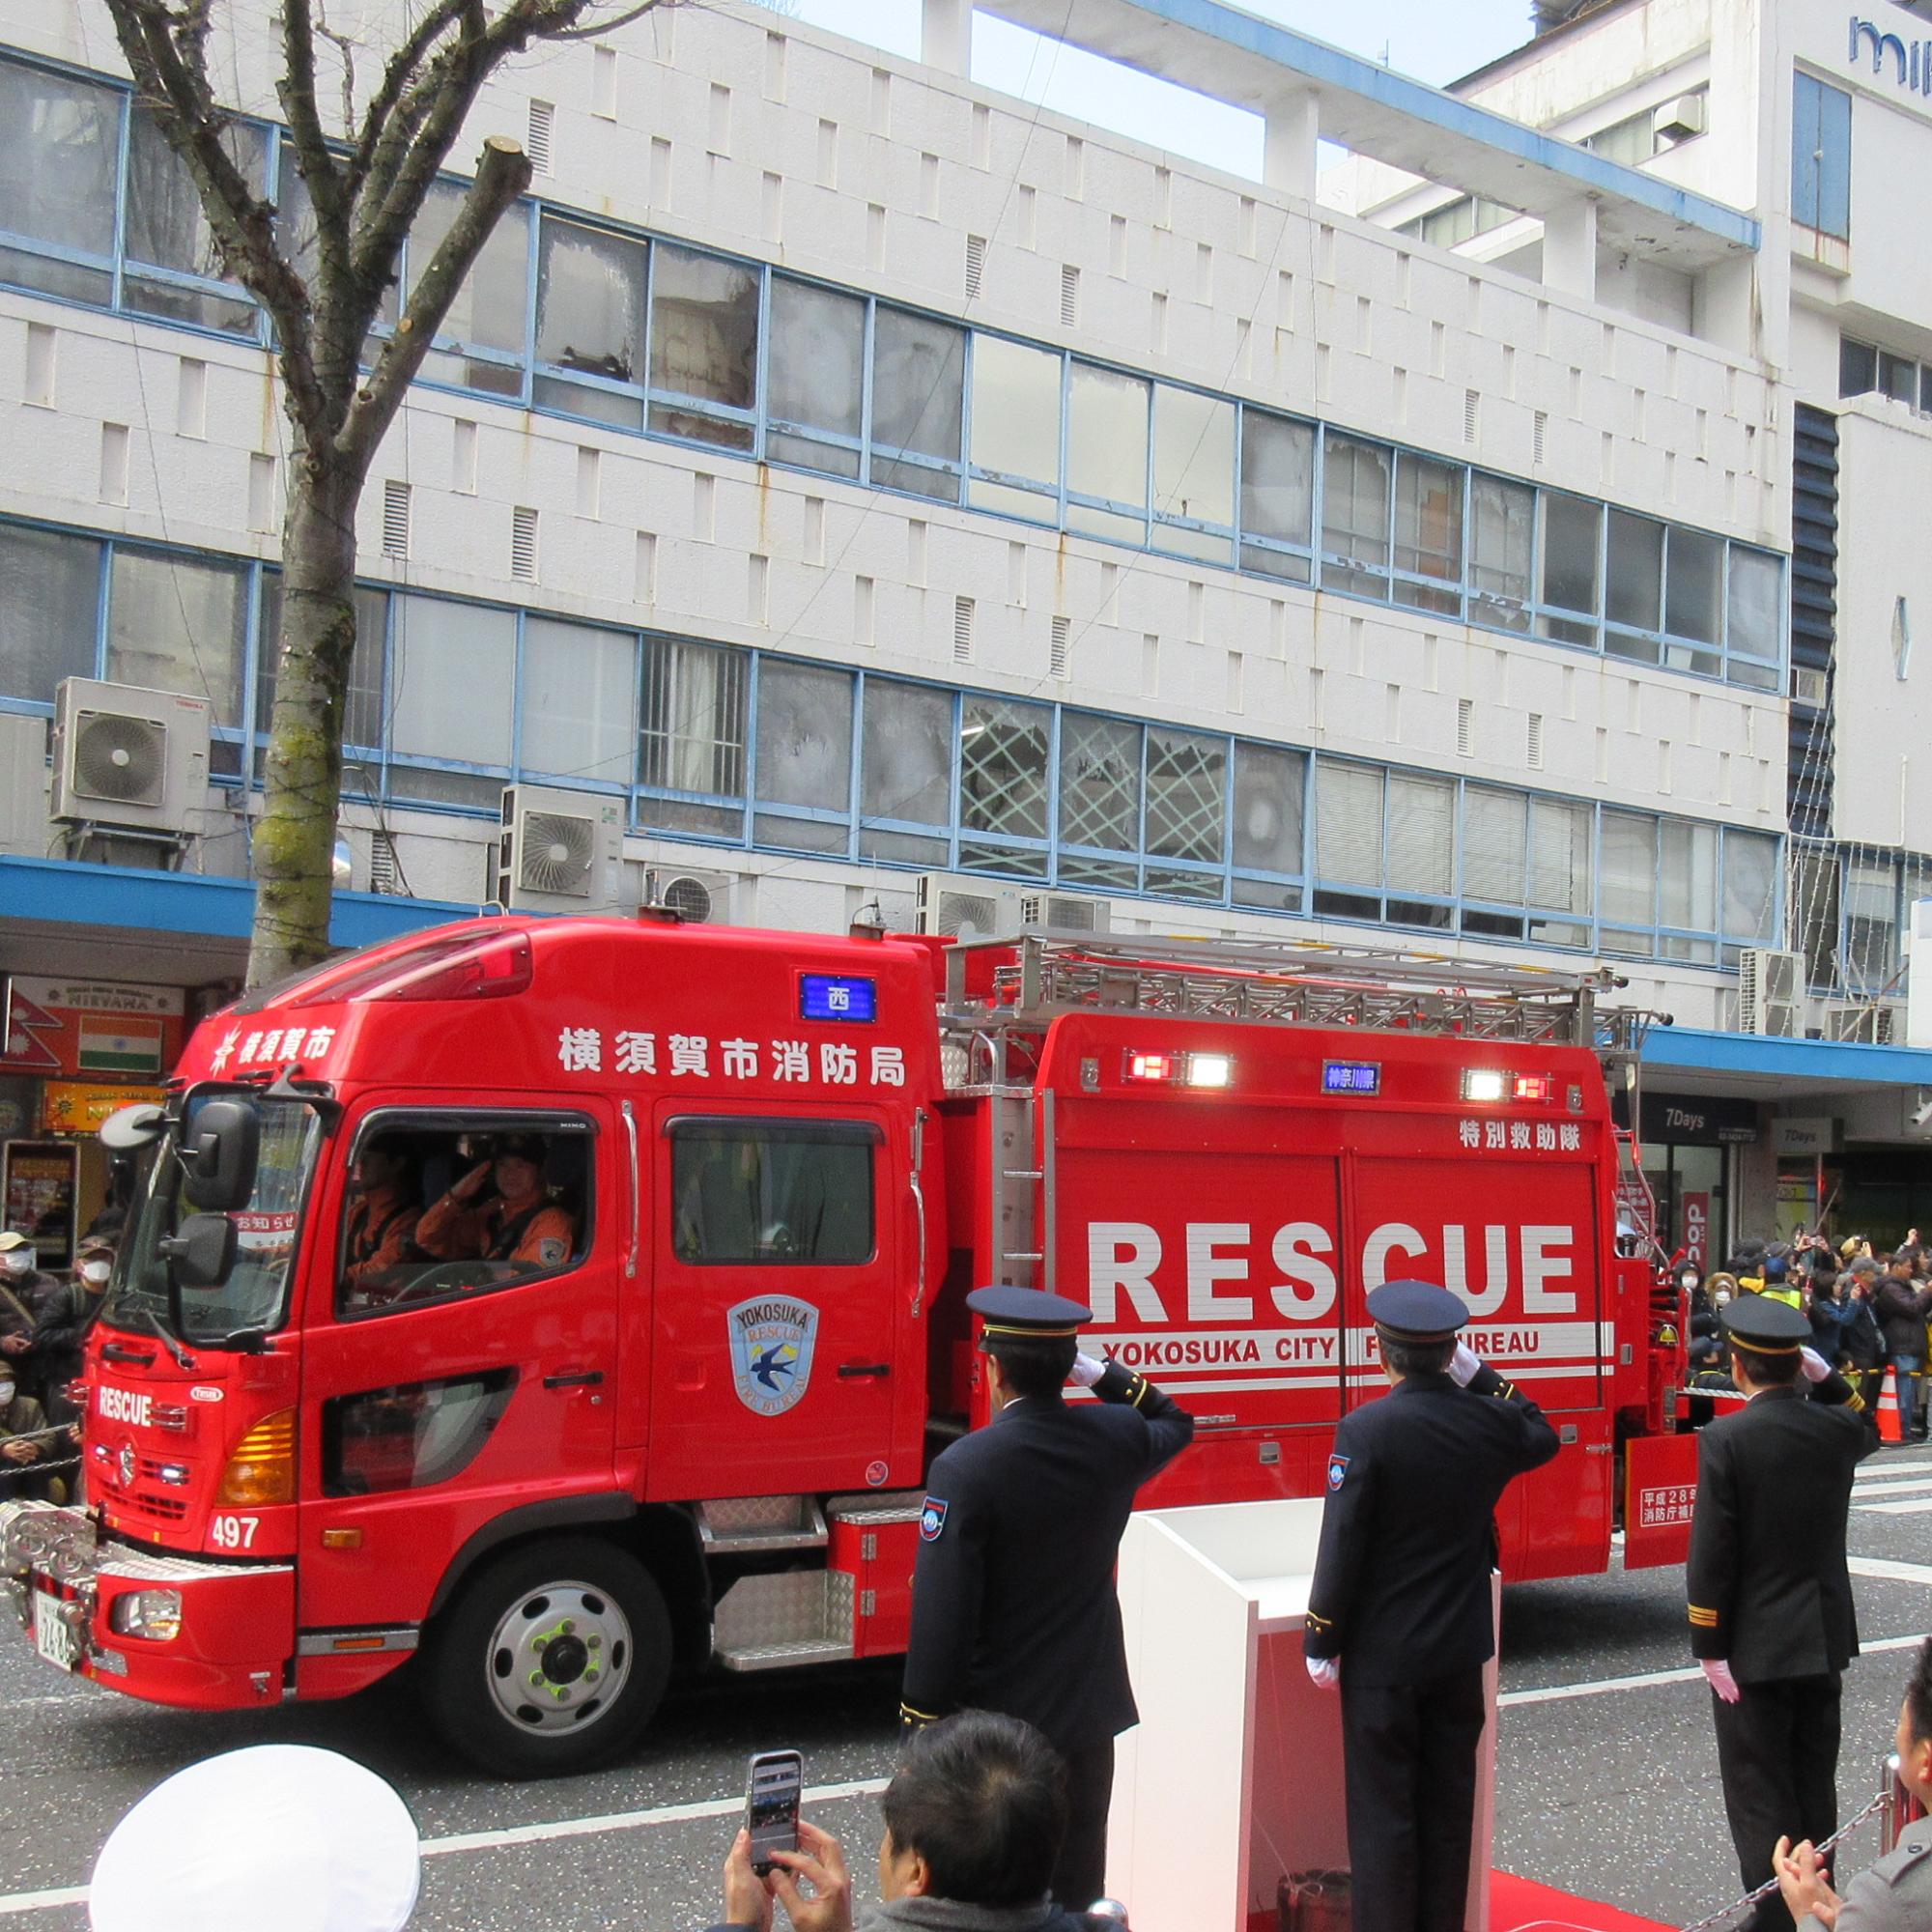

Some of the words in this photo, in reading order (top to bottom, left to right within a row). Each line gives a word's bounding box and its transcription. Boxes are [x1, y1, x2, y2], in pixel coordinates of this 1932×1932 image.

[828, 986, 849, 1011] 西
[239, 1026, 336, 1065] 横須賀市
[558, 1027, 905, 1087] 横須賀市消防局
[1328, 1067, 1375, 1090] 神奈川県
[1665, 1108, 1704, 1131] 7Days
[1460, 1120, 1580, 1151] 特別救助隊
[1785, 1128, 1816, 1145] 7Days
[1088, 1221, 1577, 1322] RESCUE
[736, 1303, 809, 1330] YOKOSUKA
[748, 1324, 801, 1343] RESCUE
[1102, 1339, 1261, 1367] YOKOSUKA
[1275, 1336, 1336, 1362] CITY
[99, 1386, 153, 1428] RESCUE
[212, 1516, 259, 1548] 497
